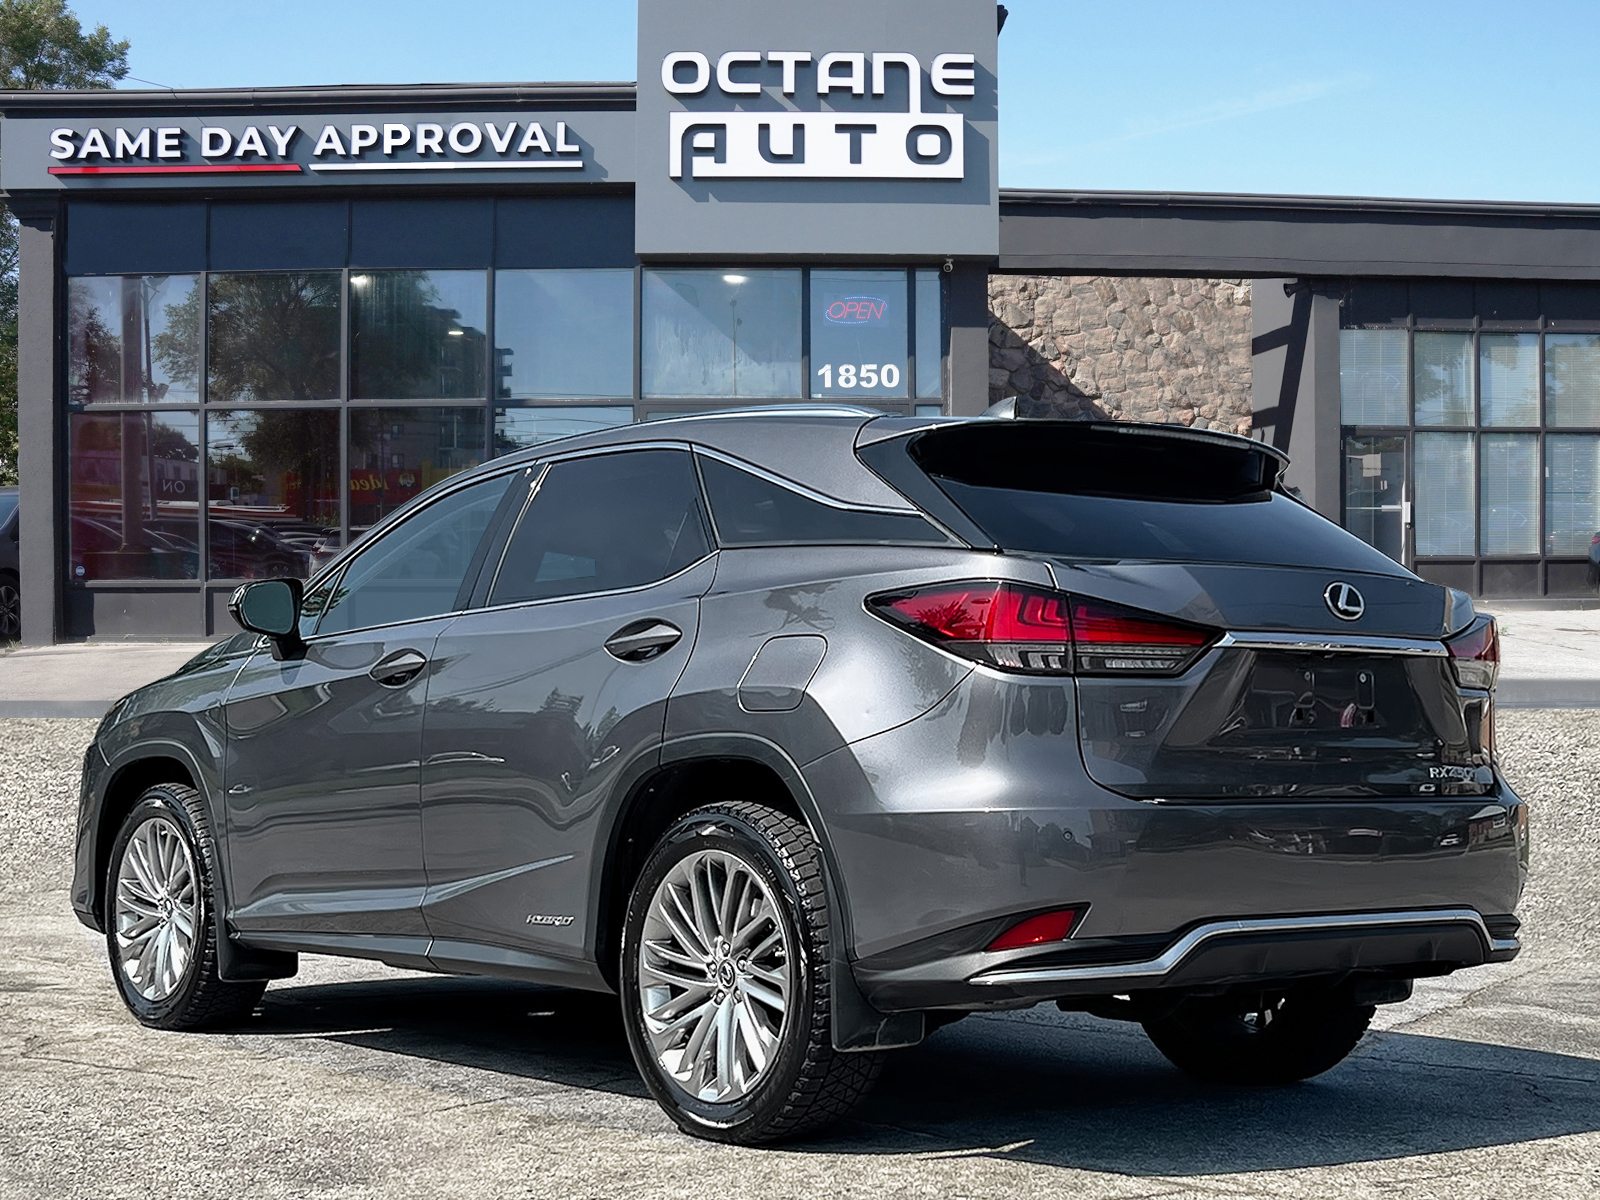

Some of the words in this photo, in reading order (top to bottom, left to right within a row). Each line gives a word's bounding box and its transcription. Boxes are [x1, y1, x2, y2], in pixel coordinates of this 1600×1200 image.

[661, 51, 976, 113] OCTANE
[49, 126, 182, 160] SAME
[200, 125, 299, 158] DAY
[312, 121, 580, 157] APPROVAL
[669, 112, 964, 178] AUTO
[829, 302, 885, 319] OPEN
[817, 363, 900, 389] 1850
